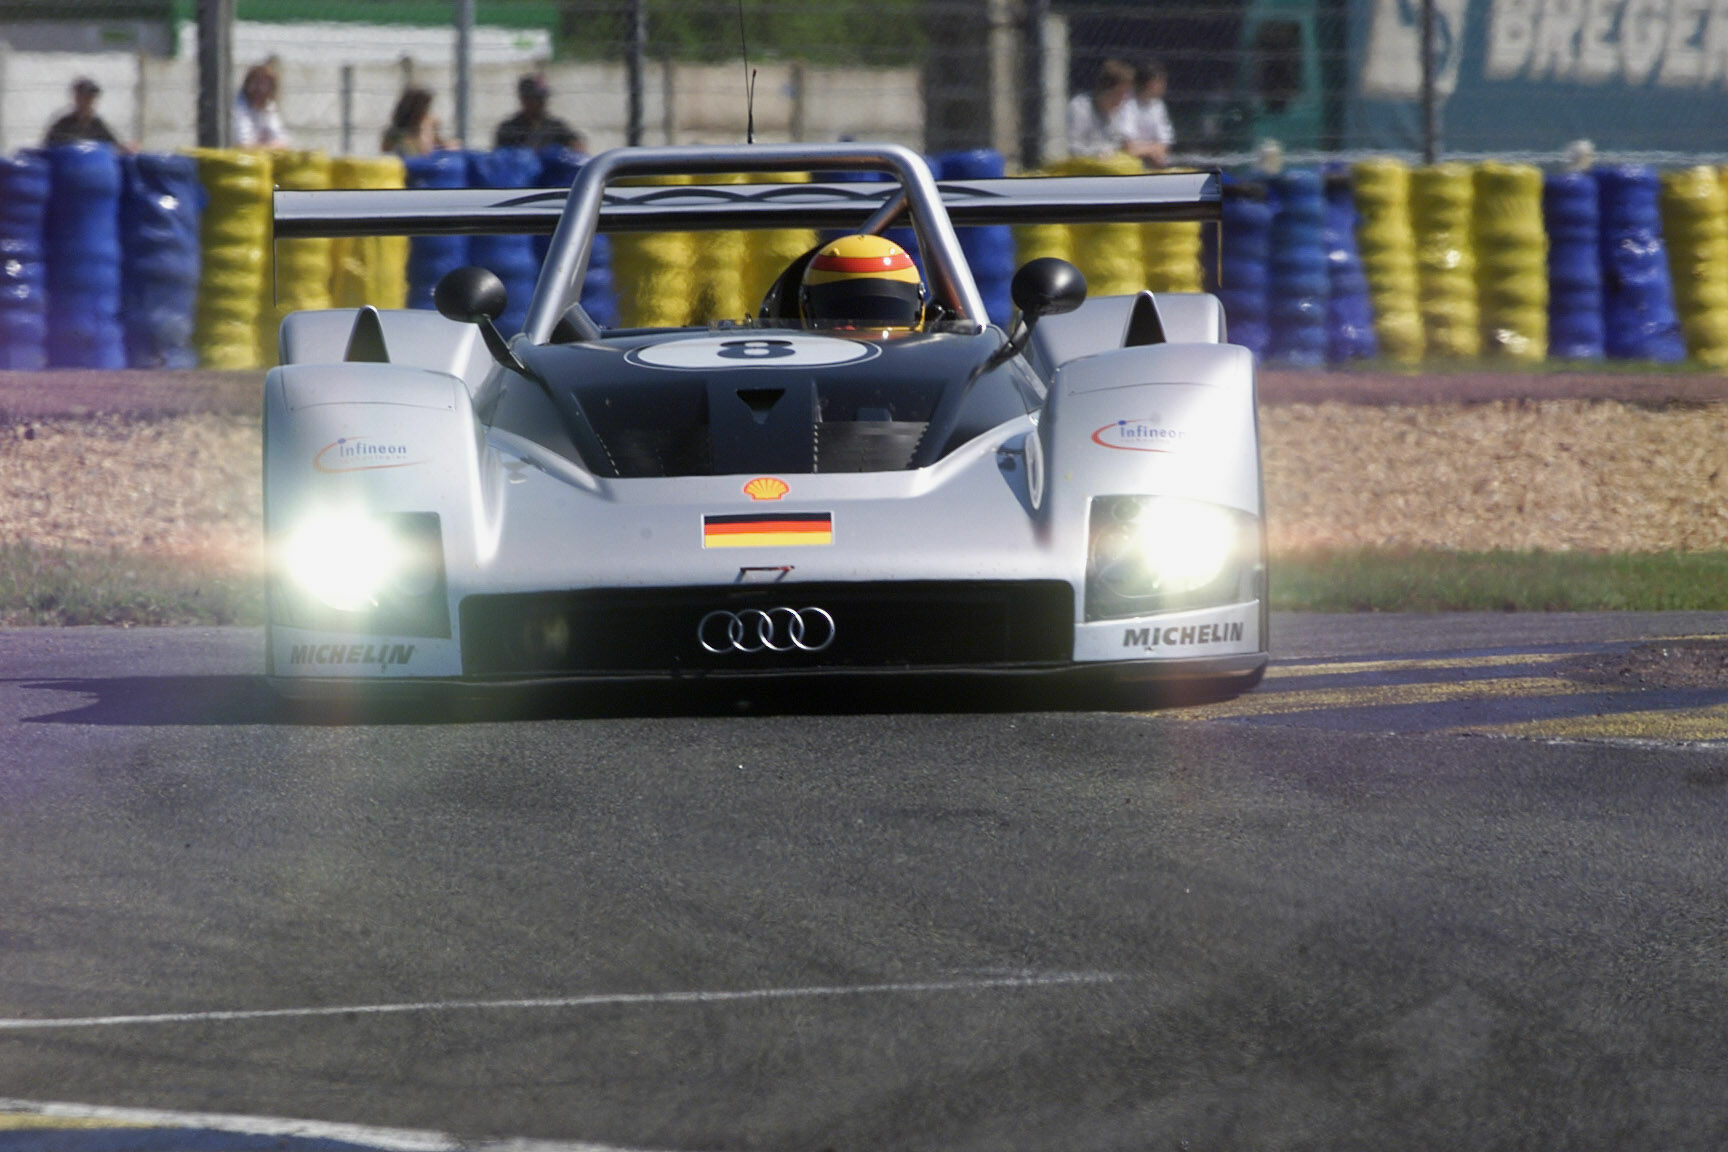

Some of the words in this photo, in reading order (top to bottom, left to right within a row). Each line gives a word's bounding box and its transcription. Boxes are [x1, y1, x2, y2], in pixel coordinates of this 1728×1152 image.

[717, 341, 795, 359] 8
[1123, 622, 1244, 647] MICHELIN
[291, 645, 415, 664] MICHELIN
